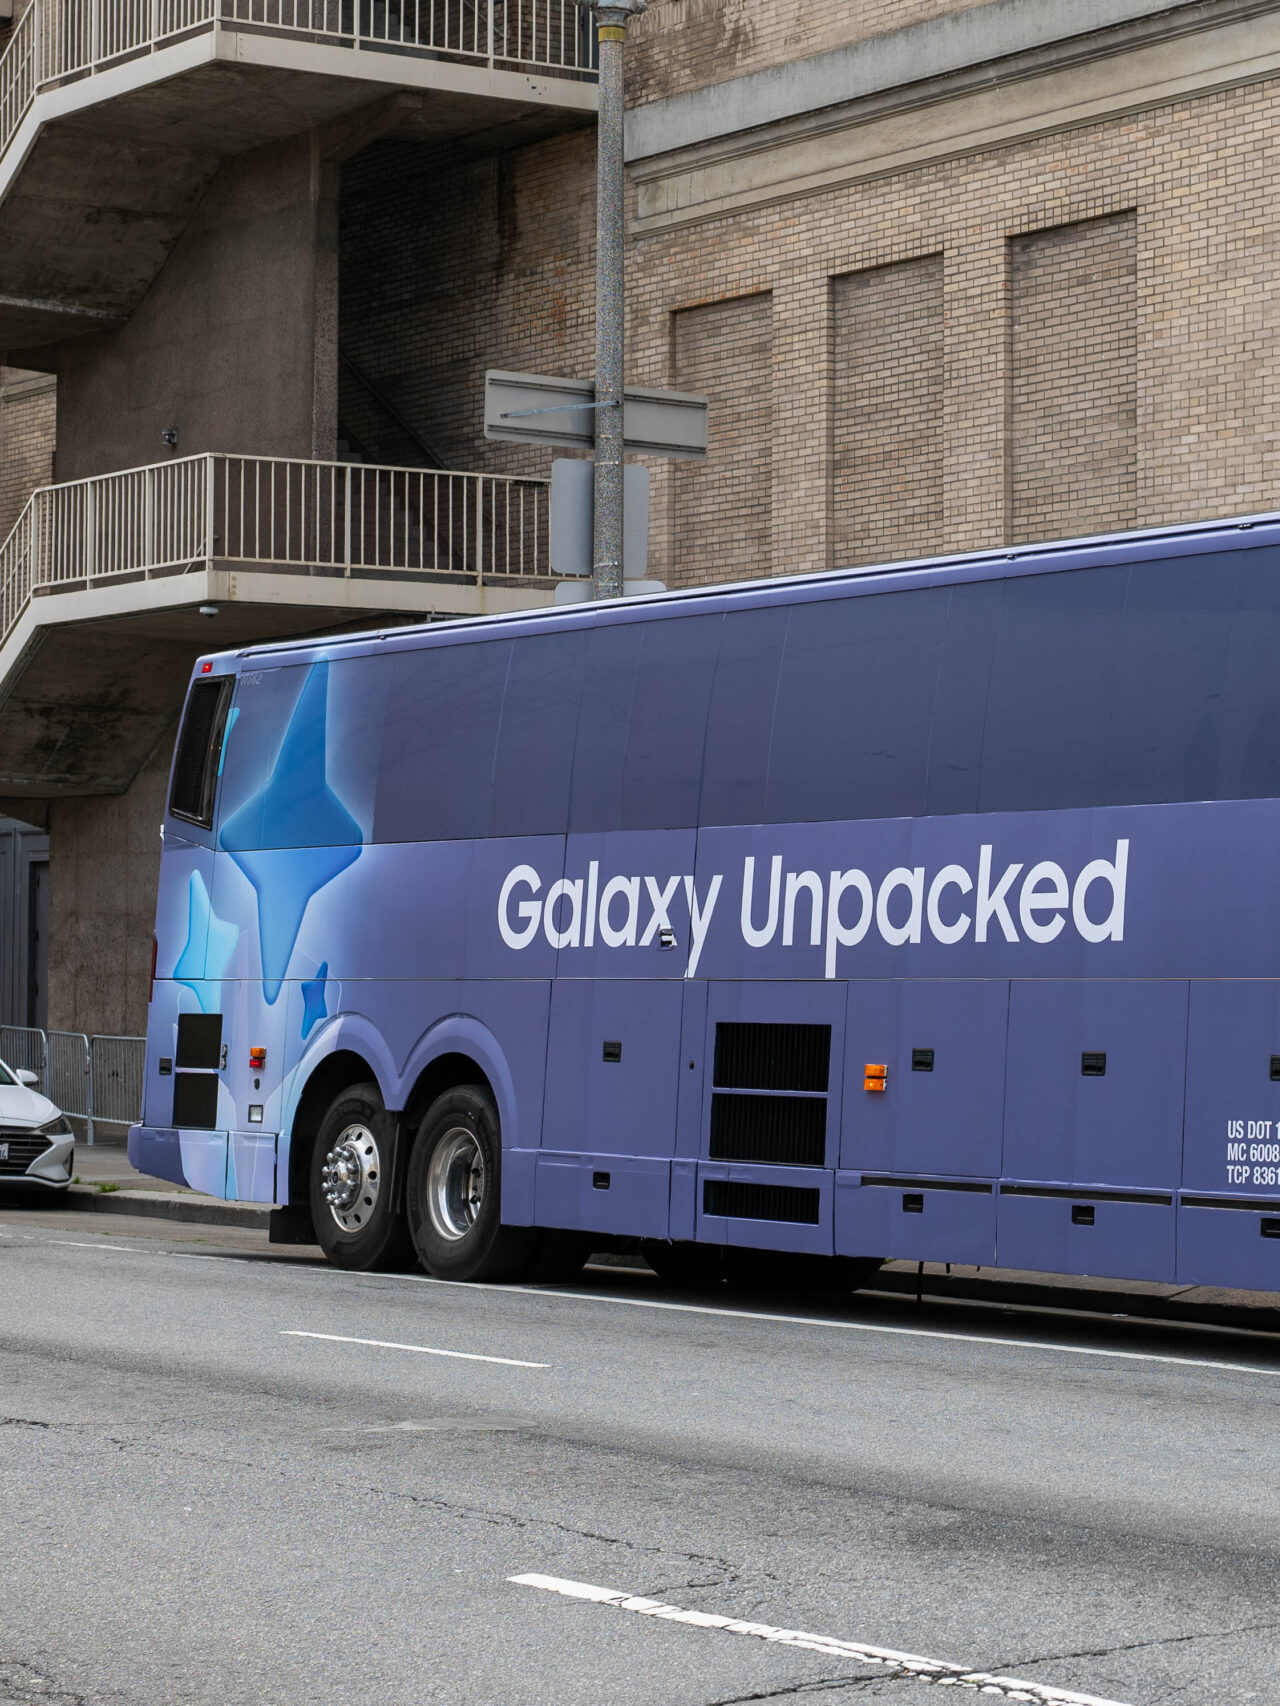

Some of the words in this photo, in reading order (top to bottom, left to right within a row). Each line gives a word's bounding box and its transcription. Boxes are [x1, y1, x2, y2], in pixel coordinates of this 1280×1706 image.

[497, 860, 723, 980] Galaxy
[740, 838, 1130, 978] Unpacked
[1227, 1120, 1244, 1139] US
[1247, 1120, 1272, 1139] DOT
[1227, 1143, 1247, 1161] MC
[1226, 1165, 1250, 1184] TCP
